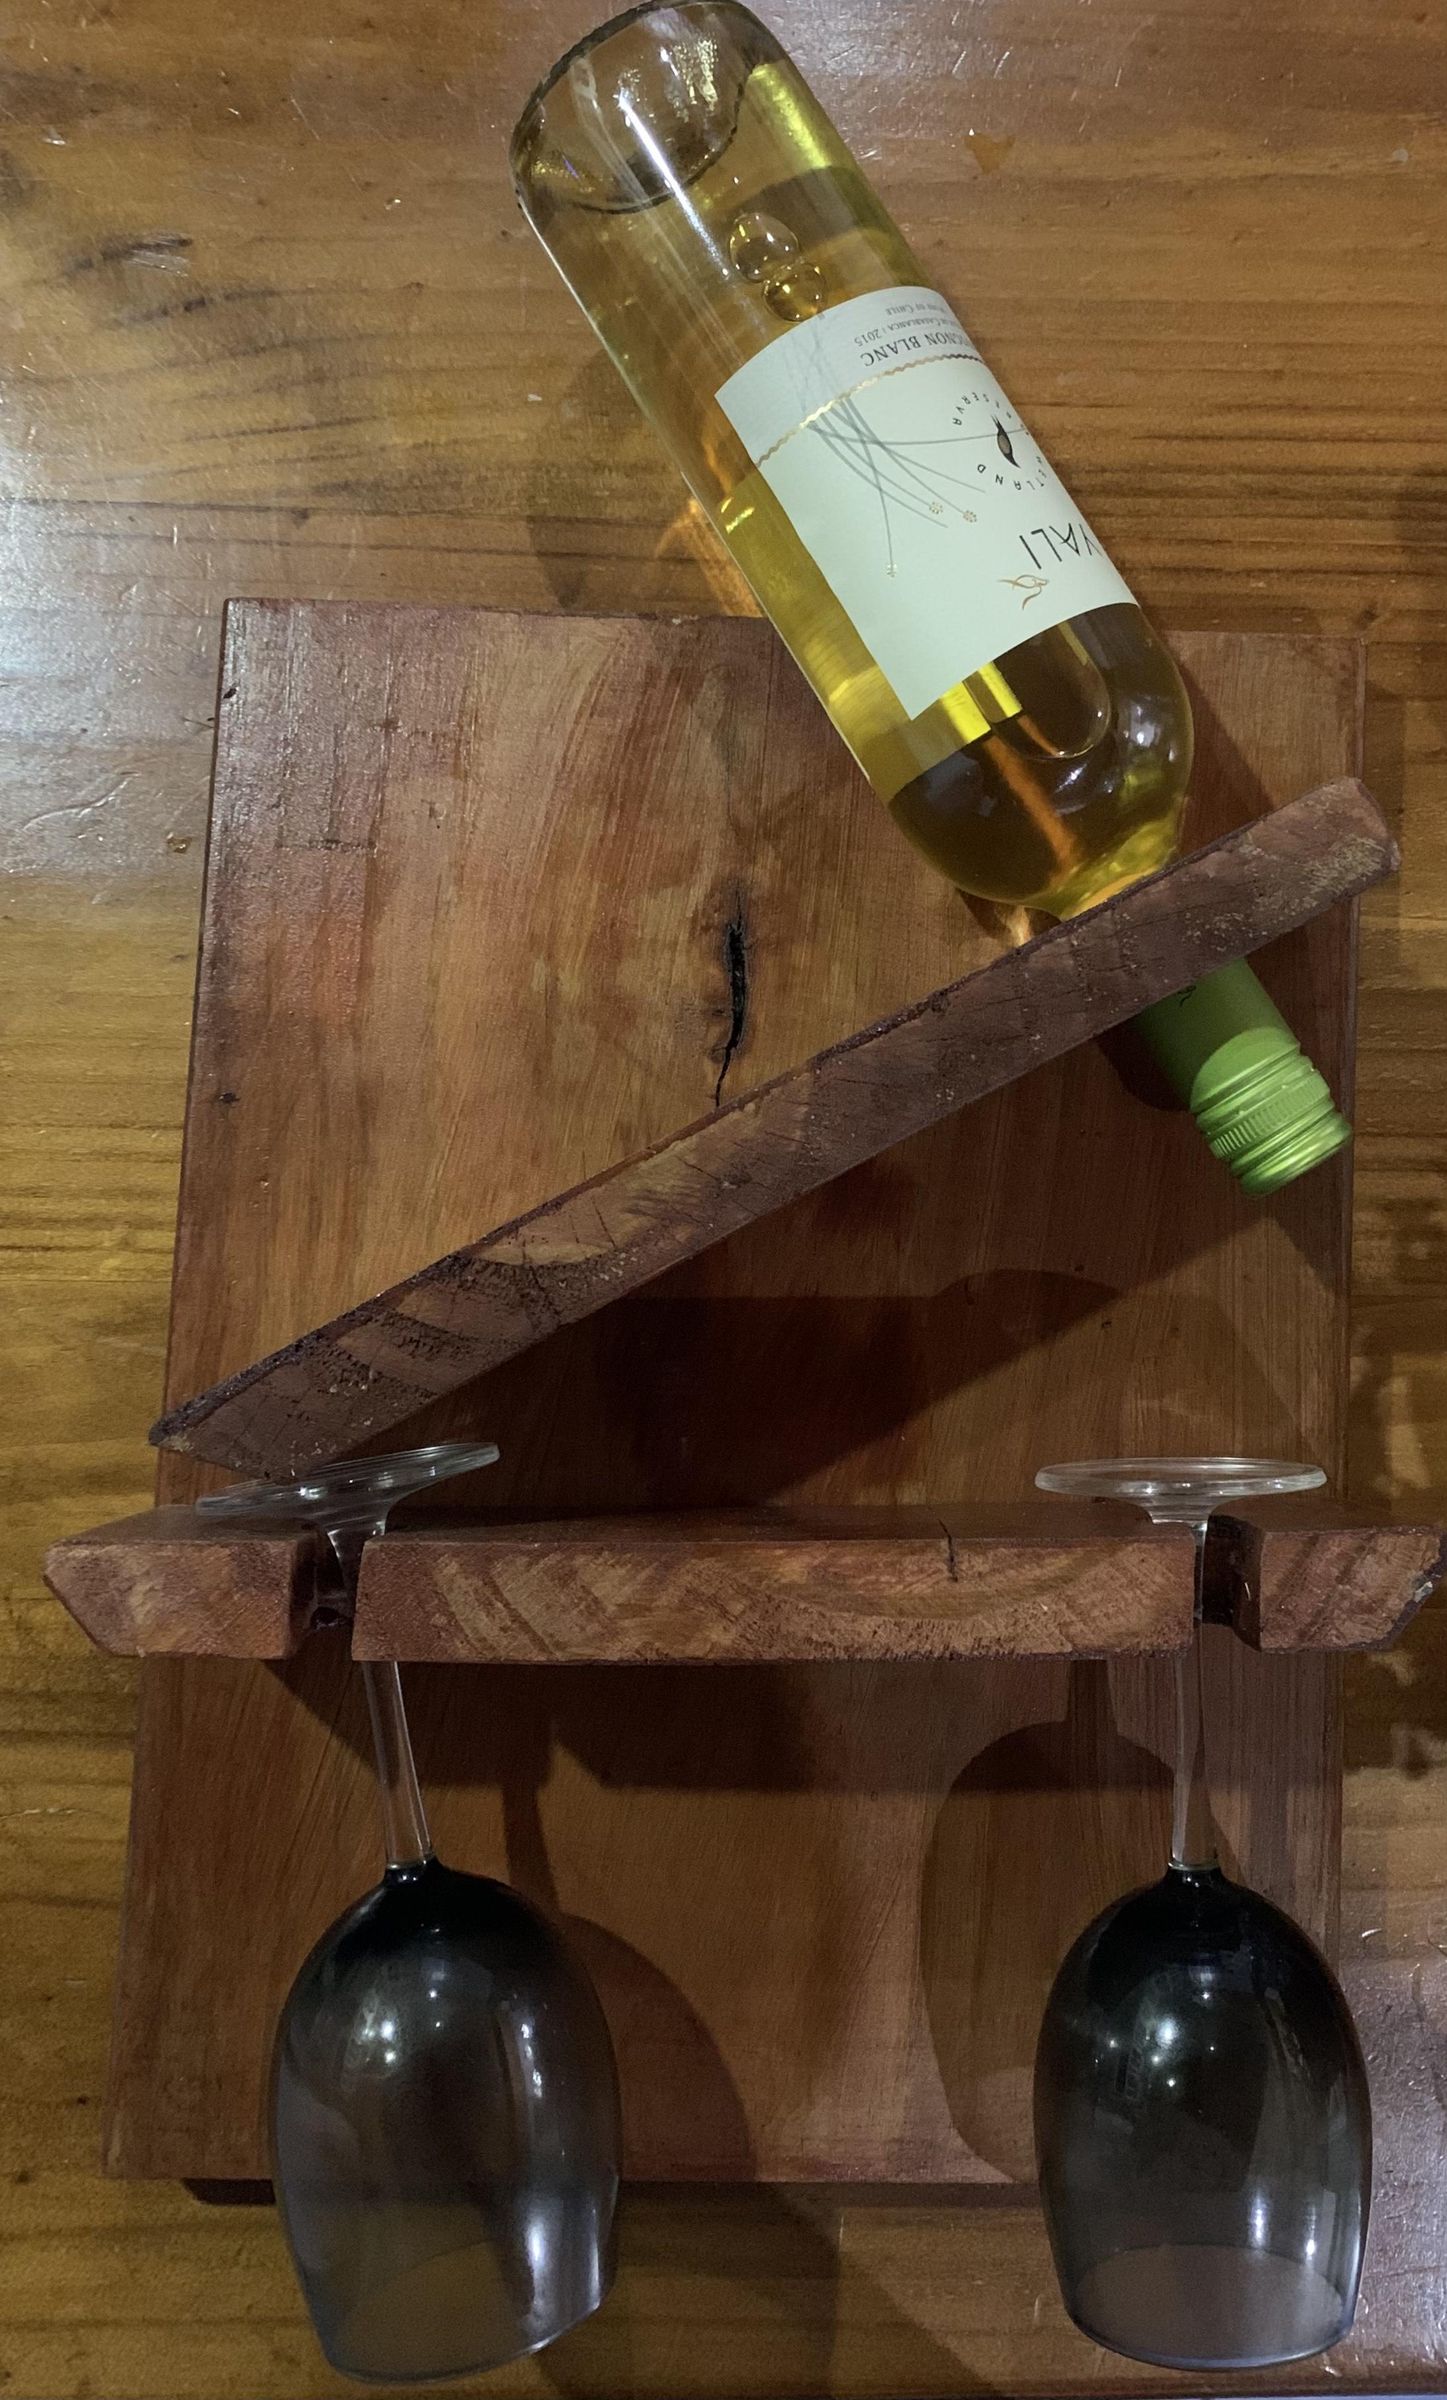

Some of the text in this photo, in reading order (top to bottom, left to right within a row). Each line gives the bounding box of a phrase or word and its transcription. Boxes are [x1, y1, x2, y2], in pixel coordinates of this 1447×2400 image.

[854, 328, 882, 347] 2015
[860, 335, 921, 367] BLANC
[1019, 522, 1104, 570] YALI
